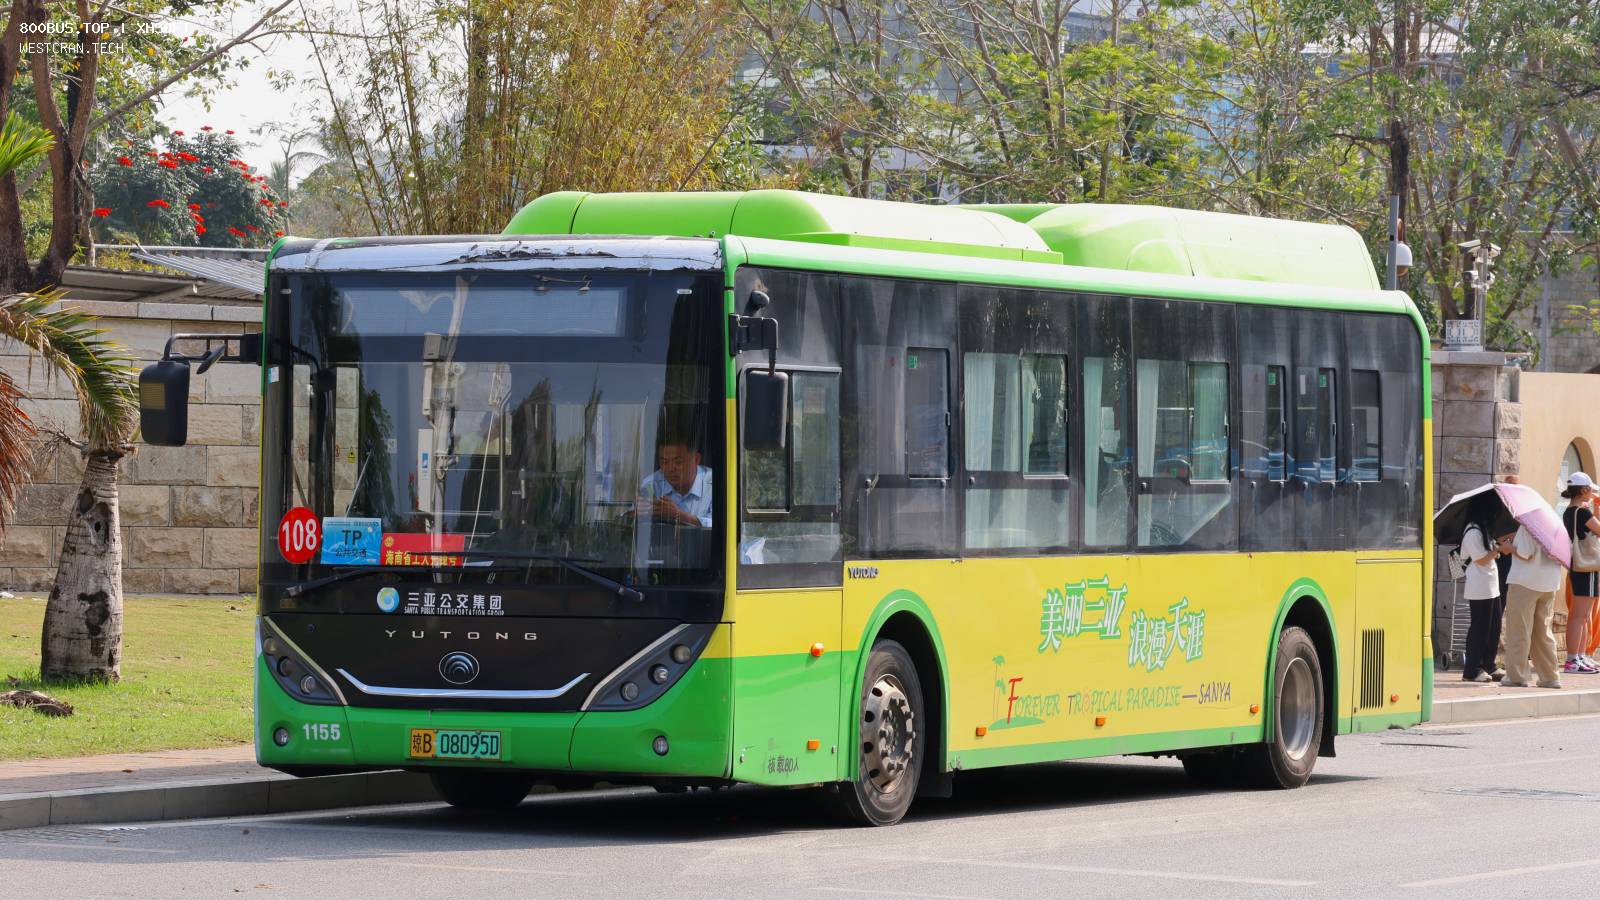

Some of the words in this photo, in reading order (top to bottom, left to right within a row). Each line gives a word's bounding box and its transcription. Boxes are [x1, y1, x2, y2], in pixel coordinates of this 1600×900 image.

[281, 518, 318, 553] 108
[341, 529, 363, 546] TP
[335, 546, 368, 559] 公共交通
[407, 592, 503, 610] 三亚公交集团
[403, 606, 419, 615] SANYA
[420, 607, 435, 615] PUBLIC
[437, 608, 486, 616] TRANSPORTATION
[487, 609, 505, 617] GROUP
[1039, 573, 1129, 654] 美丽三亚
[1127, 596, 1206, 673] 浪漫天涯
[385, 629, 538, 641] YUTONG
[1007, 677, 1061, 724] FOREVER
[302, 723, 341, 741] 1155
